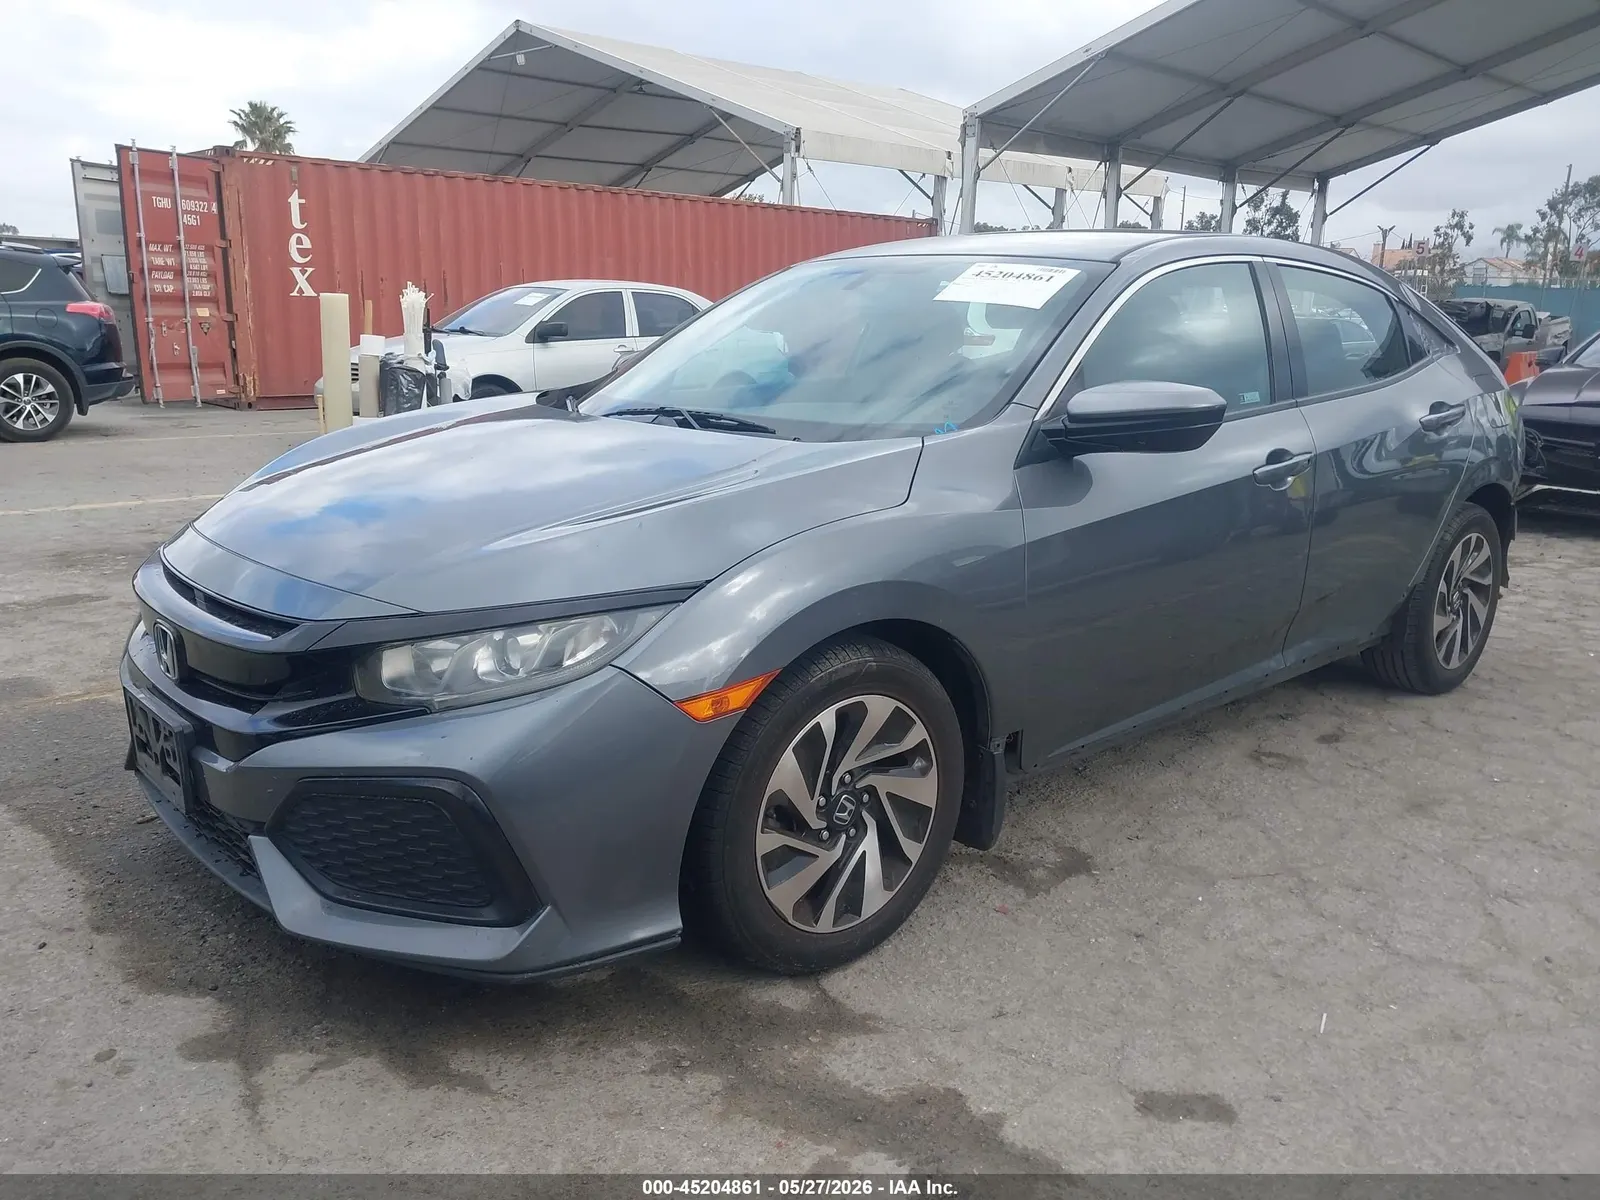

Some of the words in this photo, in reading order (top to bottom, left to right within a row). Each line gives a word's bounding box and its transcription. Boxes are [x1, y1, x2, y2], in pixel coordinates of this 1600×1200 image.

[152, 196, 171, 208] TGHU
[181, 199, 208, 212] 609322
[210, 202, 218, 214] 4
[183, 214, 200, 225] 45G1
[288, 189, 317, 296] tex
[1415, 242, 1426, 255] 5
[1574, 246, 1584, 259] 4
[151, 270, 174, 279] PAYLOAD
[971, 270, 1055, 283] 45204861
